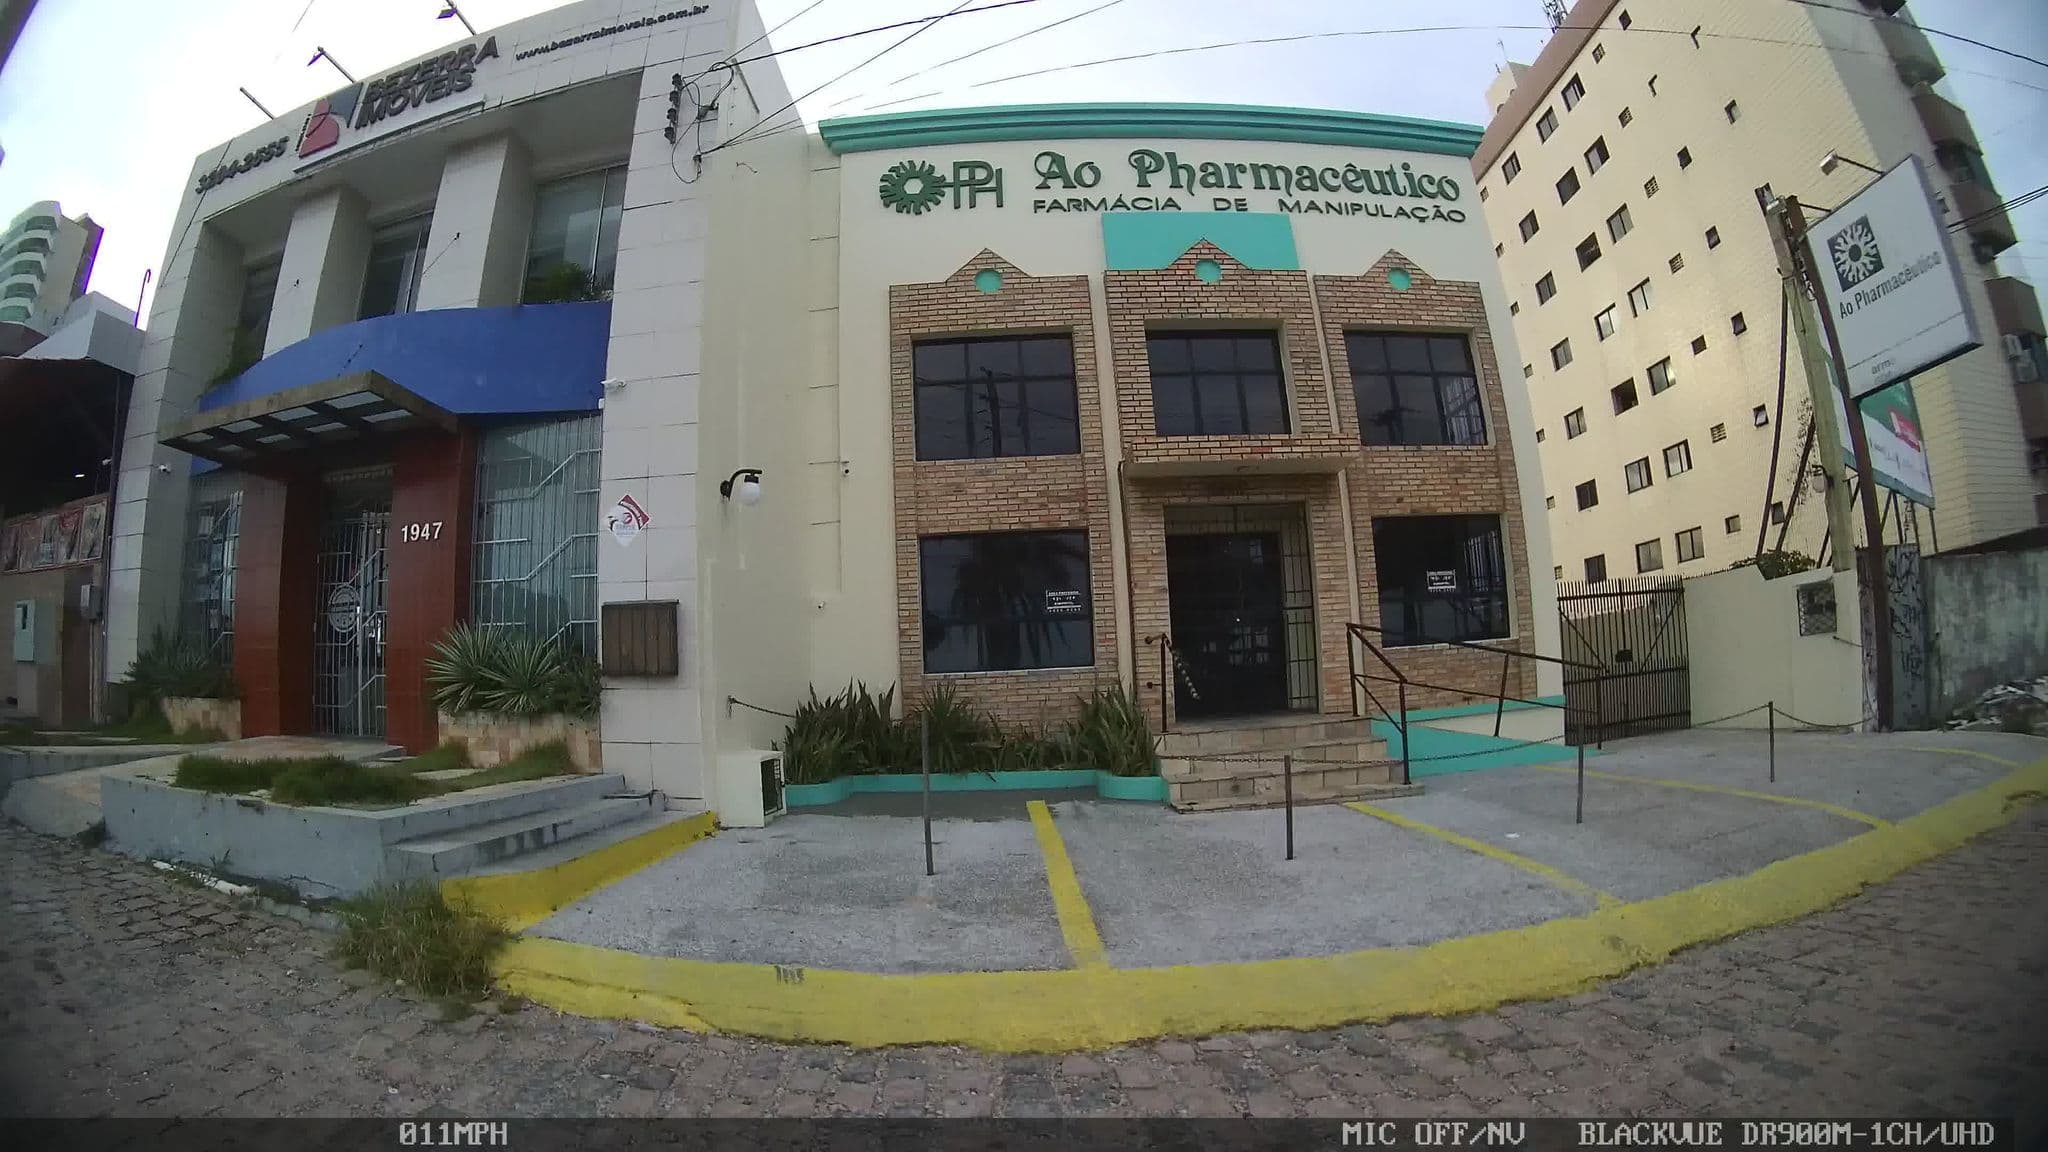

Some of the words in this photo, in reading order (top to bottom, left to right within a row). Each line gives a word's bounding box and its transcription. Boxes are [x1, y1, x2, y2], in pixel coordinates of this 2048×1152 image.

[366, 36, 499, 102] BEZERRA
[1034, 151, 1102, 189] Ao
[1128, 149, 1460, 201] Pharmacêutico
[1033, 194, 1182, 213] FARMÁCIA
[1213, 197, 1248, 212] DE
[1278, 198, 1466, 223] MANIPULAÇÃO
[1840, 301, 1854, 319] Ao
[401, 521, 443, 543] 1947
